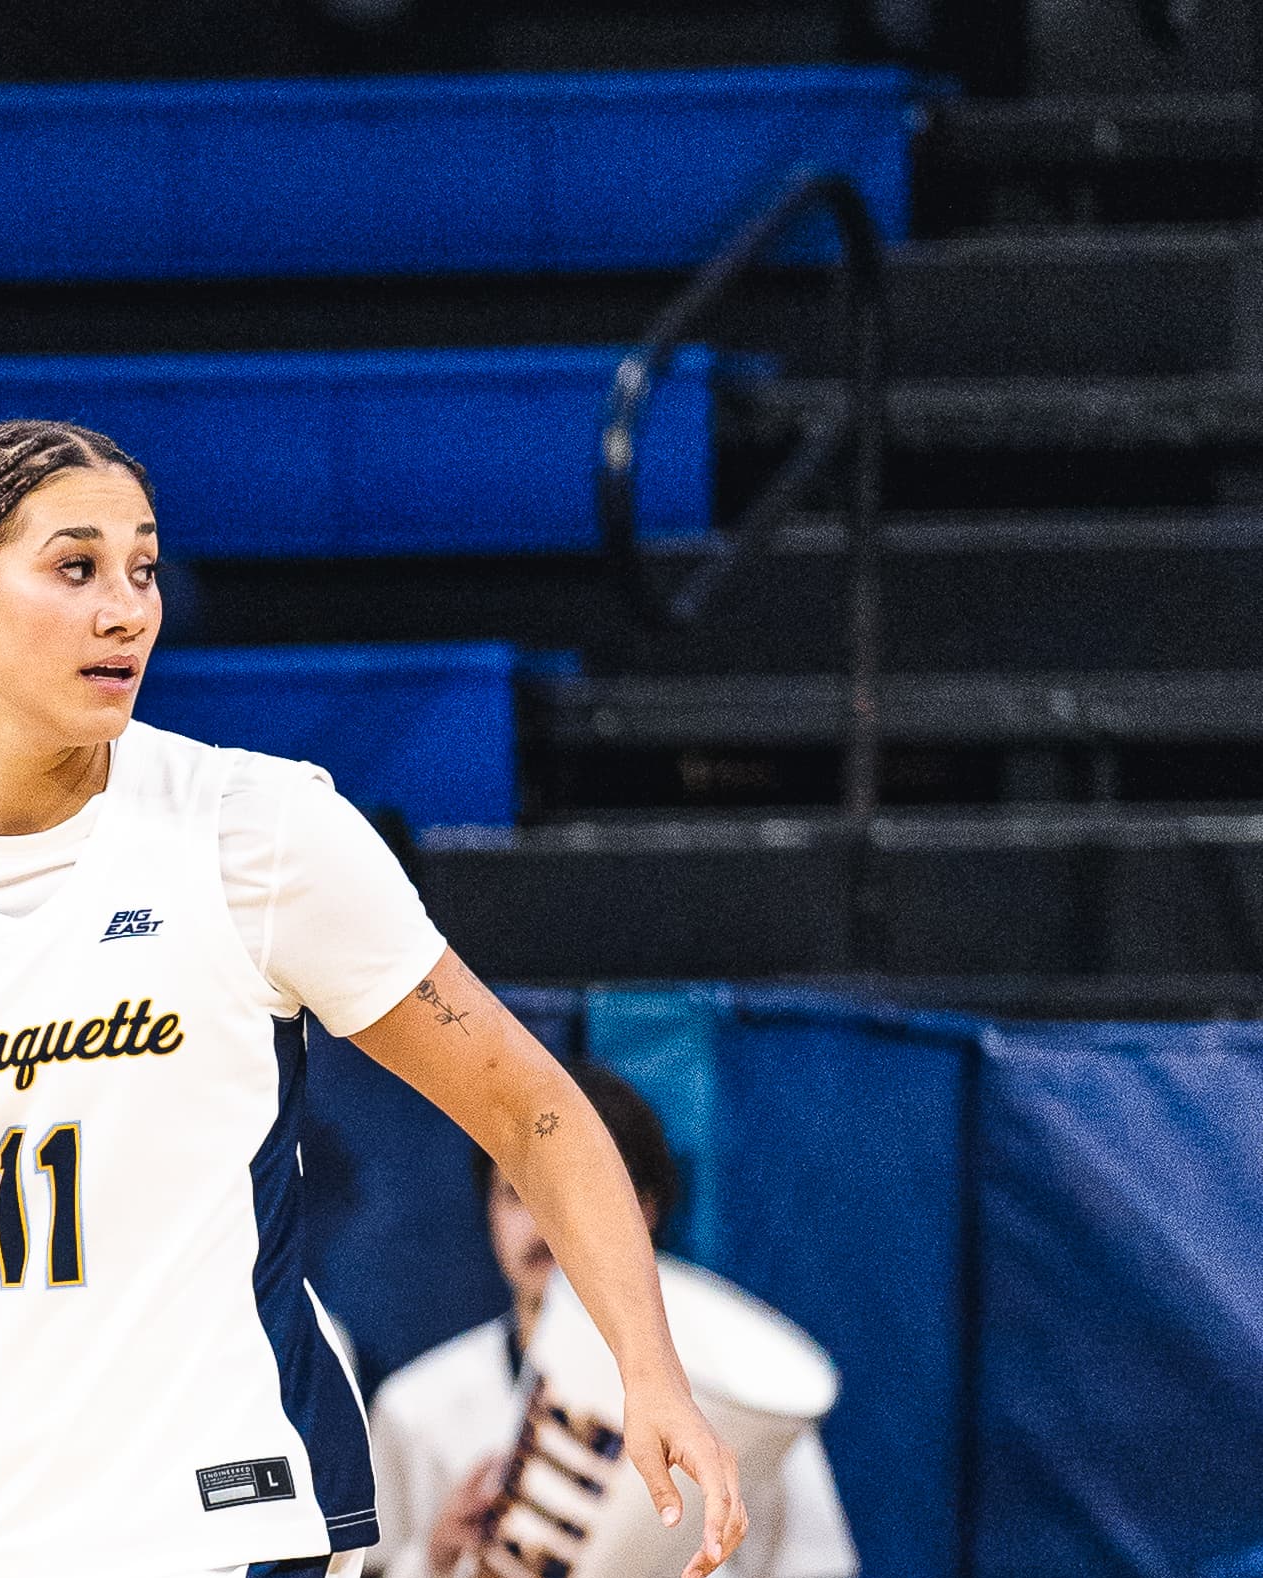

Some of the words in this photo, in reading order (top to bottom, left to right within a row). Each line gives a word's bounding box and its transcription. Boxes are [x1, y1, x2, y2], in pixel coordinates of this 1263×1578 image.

[110, 909, 153, 924] BIG
[104, 920, 164, 936] EAST
[202, 1466, 252, 1480] ENGINEERED
[266, 1470, 279, 1487] L
